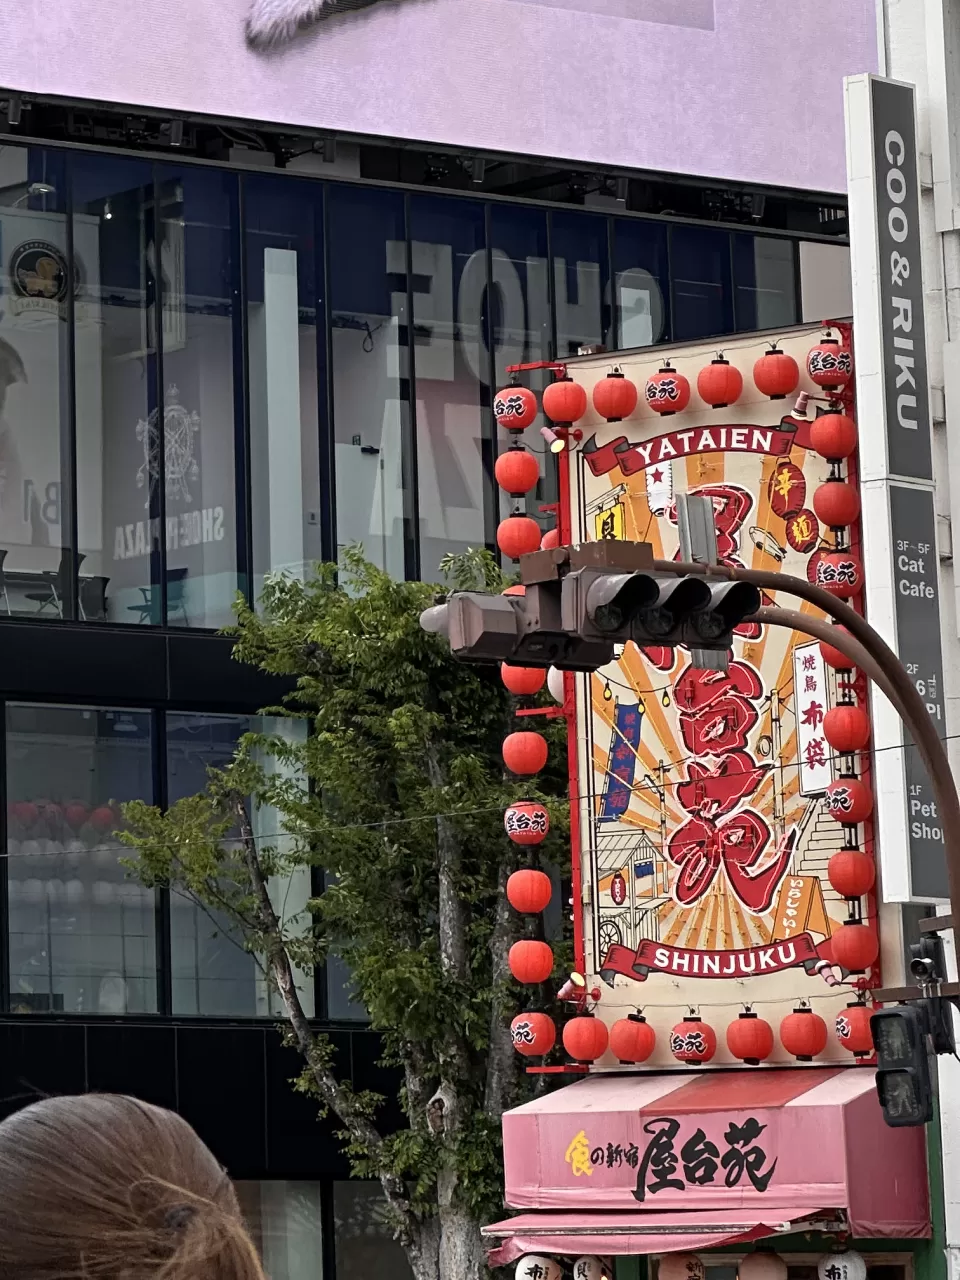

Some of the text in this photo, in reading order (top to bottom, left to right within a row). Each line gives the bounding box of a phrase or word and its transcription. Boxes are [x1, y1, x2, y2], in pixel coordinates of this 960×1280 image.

[884, 129, 918, 431] COO & RIKU
[645, 378, 679, 402] 台苑
[494, 395, 526, 418] 台苑
[636, 428, 774, 466] YATAIEN
[898, 554, 925, 574] Cat
[899, 579, 934, 599] Cafe
[906, 664, 919, 675] 2F
[799, 701, 828, 769] 布袋
[910, 785, 922, 796] 1F
[910, 800, 937, 818] Pet
[654, 942, 797, 975] SHINJUKU
[670, 1030, 707, 1055] 台苑
[564, 1117, 778, 1202] 食の新宿 屋台苑
